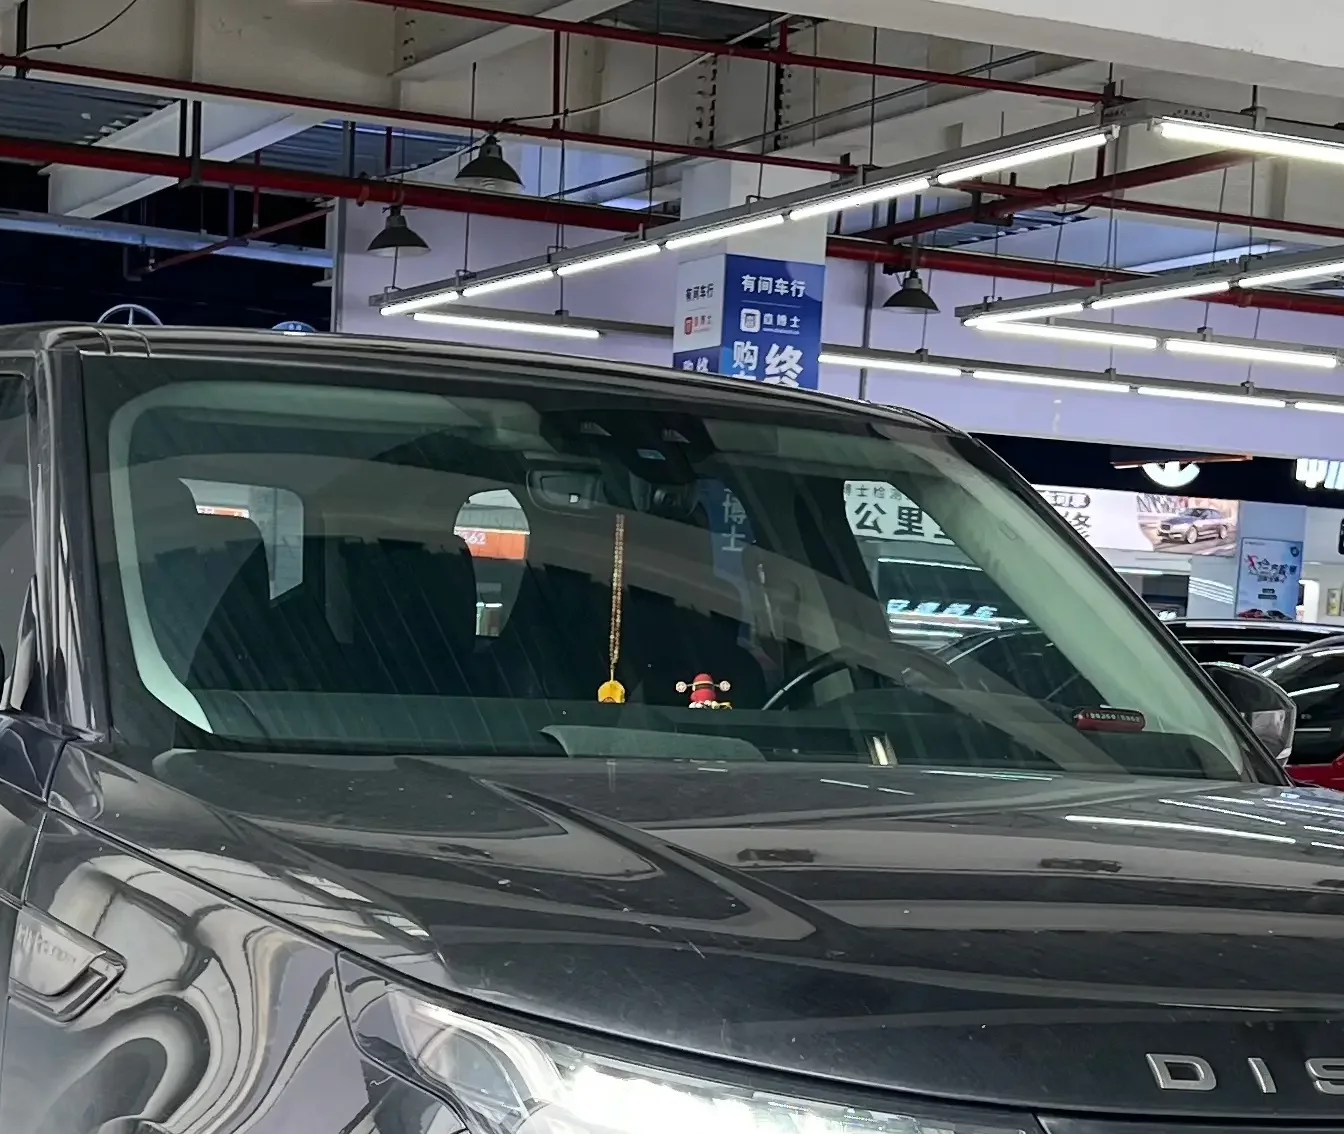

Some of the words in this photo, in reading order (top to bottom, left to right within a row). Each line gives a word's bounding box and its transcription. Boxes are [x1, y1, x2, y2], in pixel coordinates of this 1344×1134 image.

[741, 274, 806, 298] 有间车行
[854, 501, 949, 540] 公里
